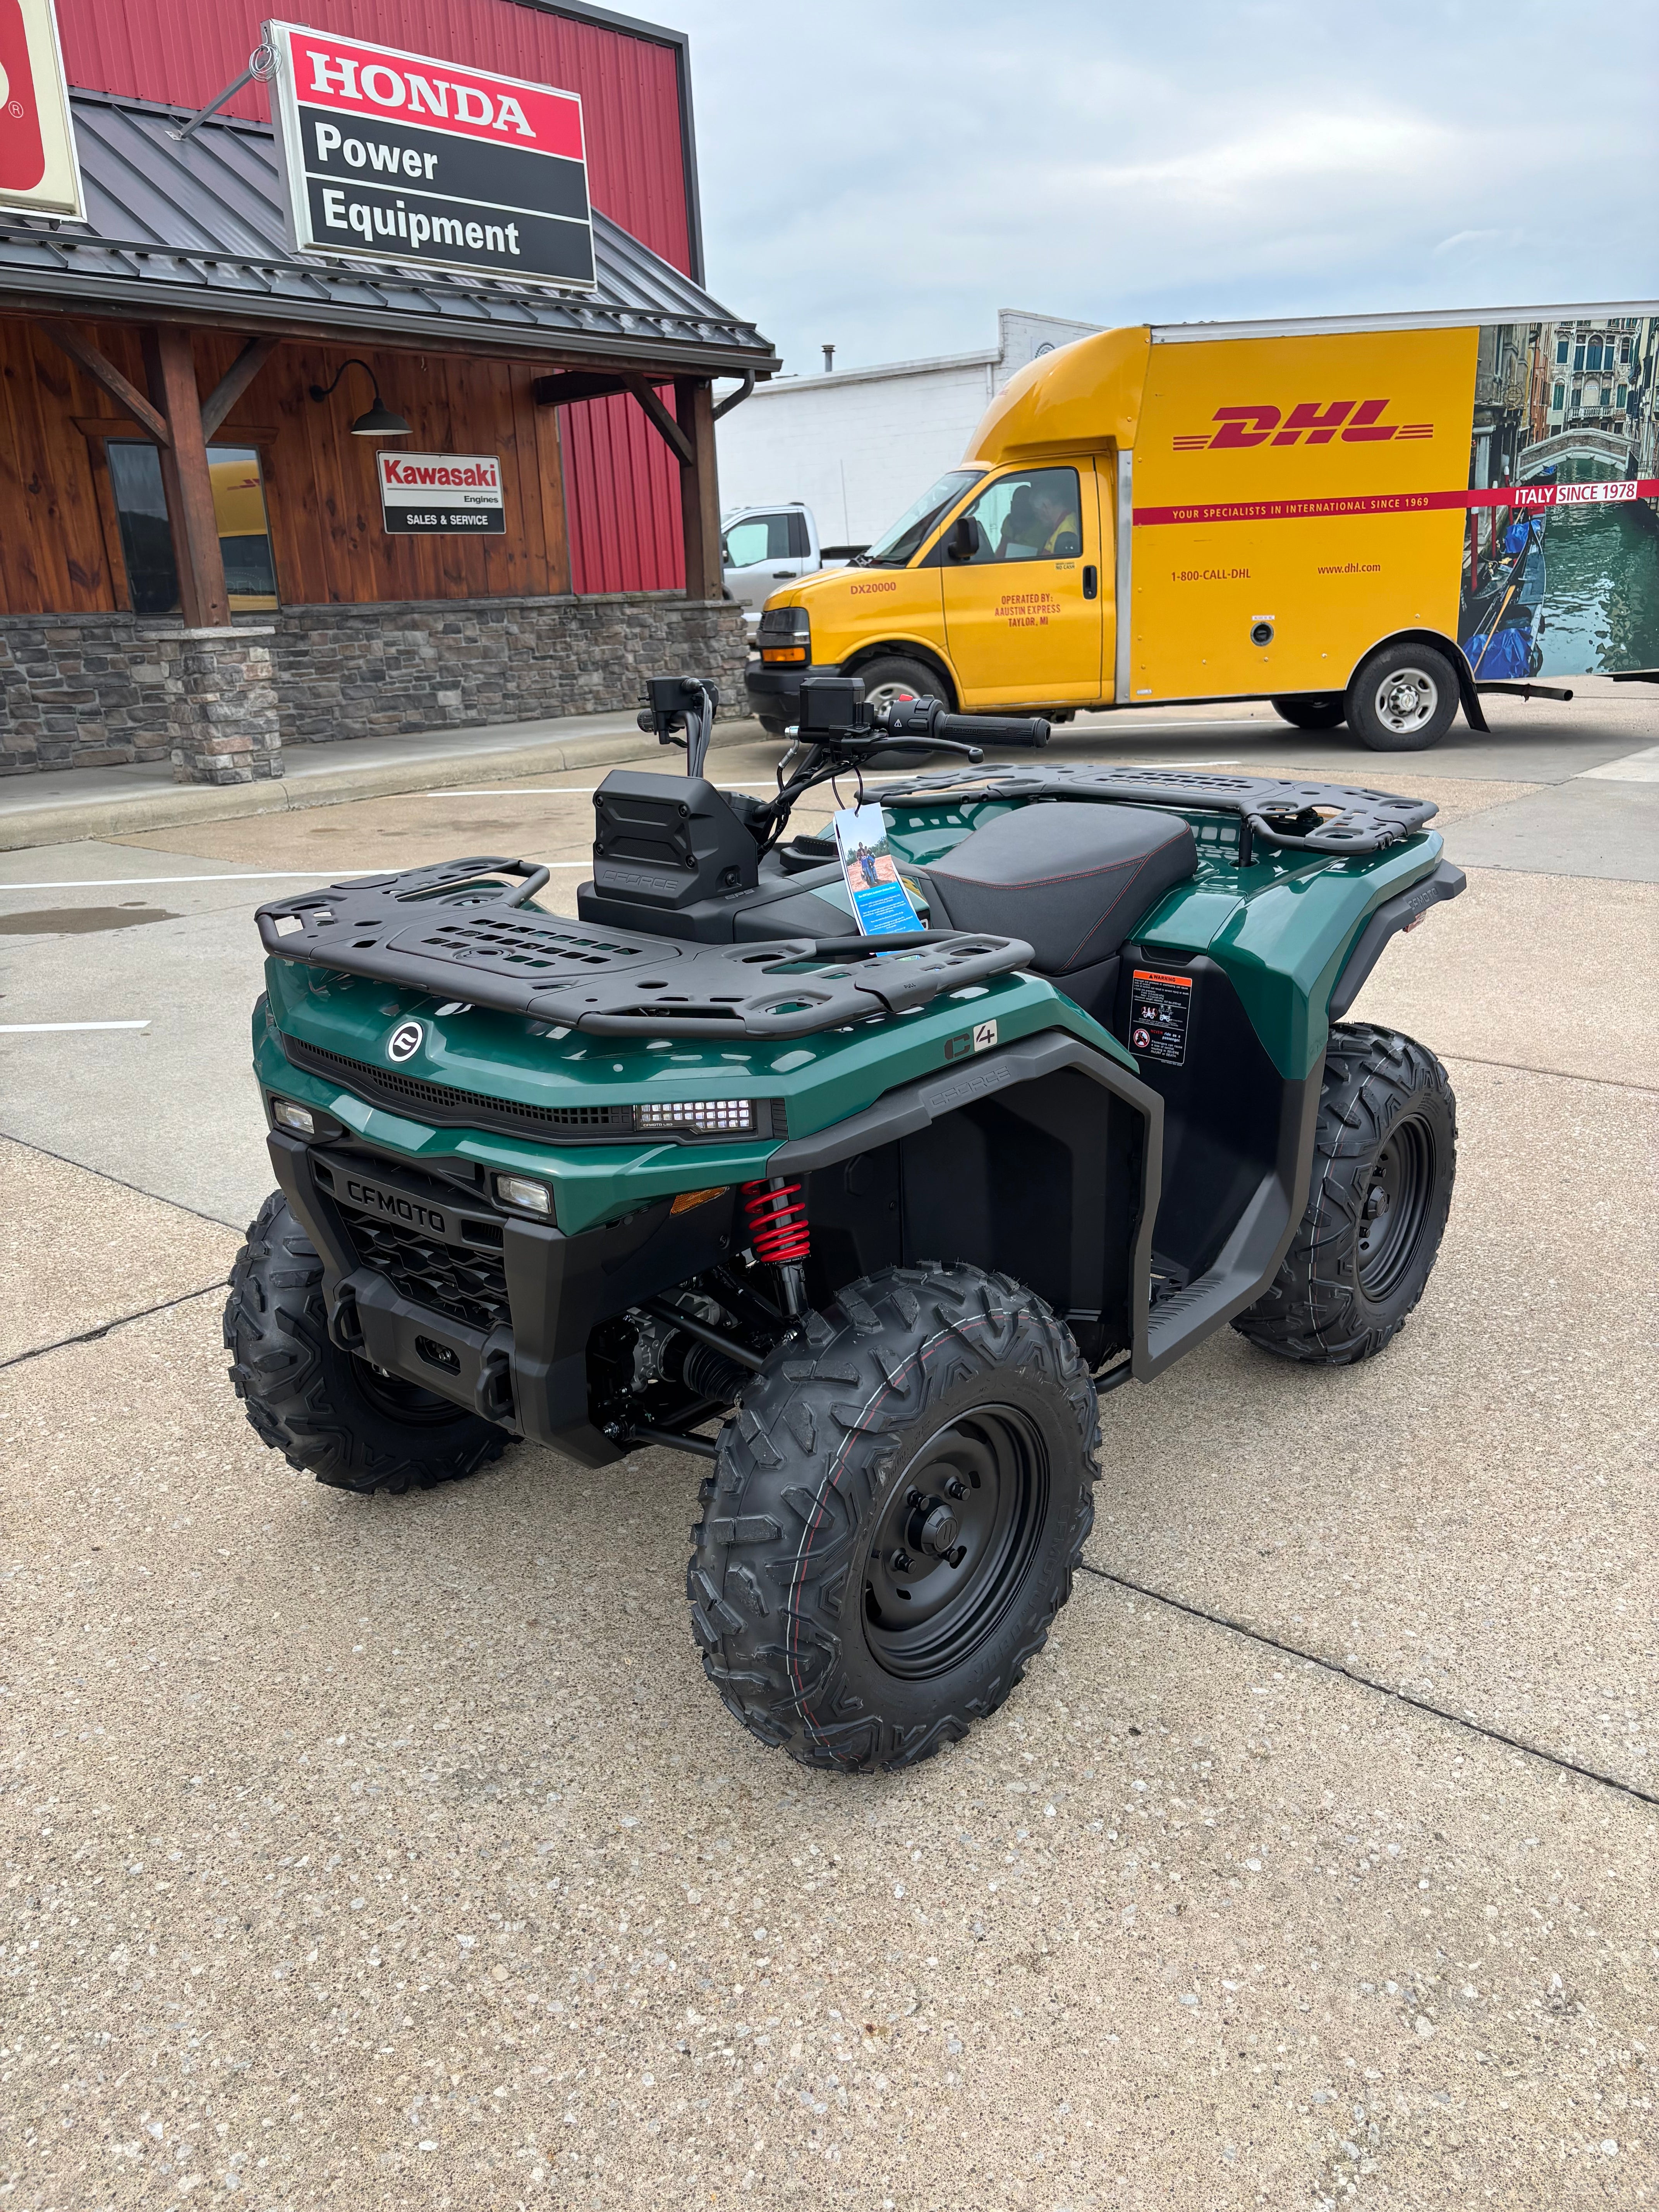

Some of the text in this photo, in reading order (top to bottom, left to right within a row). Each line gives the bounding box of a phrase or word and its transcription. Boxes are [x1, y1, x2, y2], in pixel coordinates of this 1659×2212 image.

[306, 51, 536, 137] HONDA
[315, 122, 438, 180] Power
[322, 189, 520, 255] Equipment
[1208, 399, 1399, 449] DHL
[384, 460, 496, 486] Kawasaki
[464, 495, 498, 504] Engines
[1515, 483, 1635, 505] ITALY SINCE 1978
[1173, 497, 1429, 520] YOUR SPECIALISTS IN INTERNATIONAL SINCE 1969
[407, 515, 488, 526] SALES & SERVICE
[1171, 568, 1251, 581] 1-800-CALL-DHL
[1318, 563, 1381, 574] www.dhl.com
[850, 582, 896, 595] DX20000
[1001, 593, 1053, 605] OPERATED BY:
[995, 604, 1061, 616] AAUSTIN EXPRESS
[1008, 617, 1048, 627] TAYLOR, MI
[603, 870, 678, 891] CFORCE
[725, 888, 756, 900] EPS
[1408, 887, 1438, 910] CFMOTO
[929, 1066, 1010, 1107] CFORCE
[348, 1180, 445, 1233] CFMOTO
